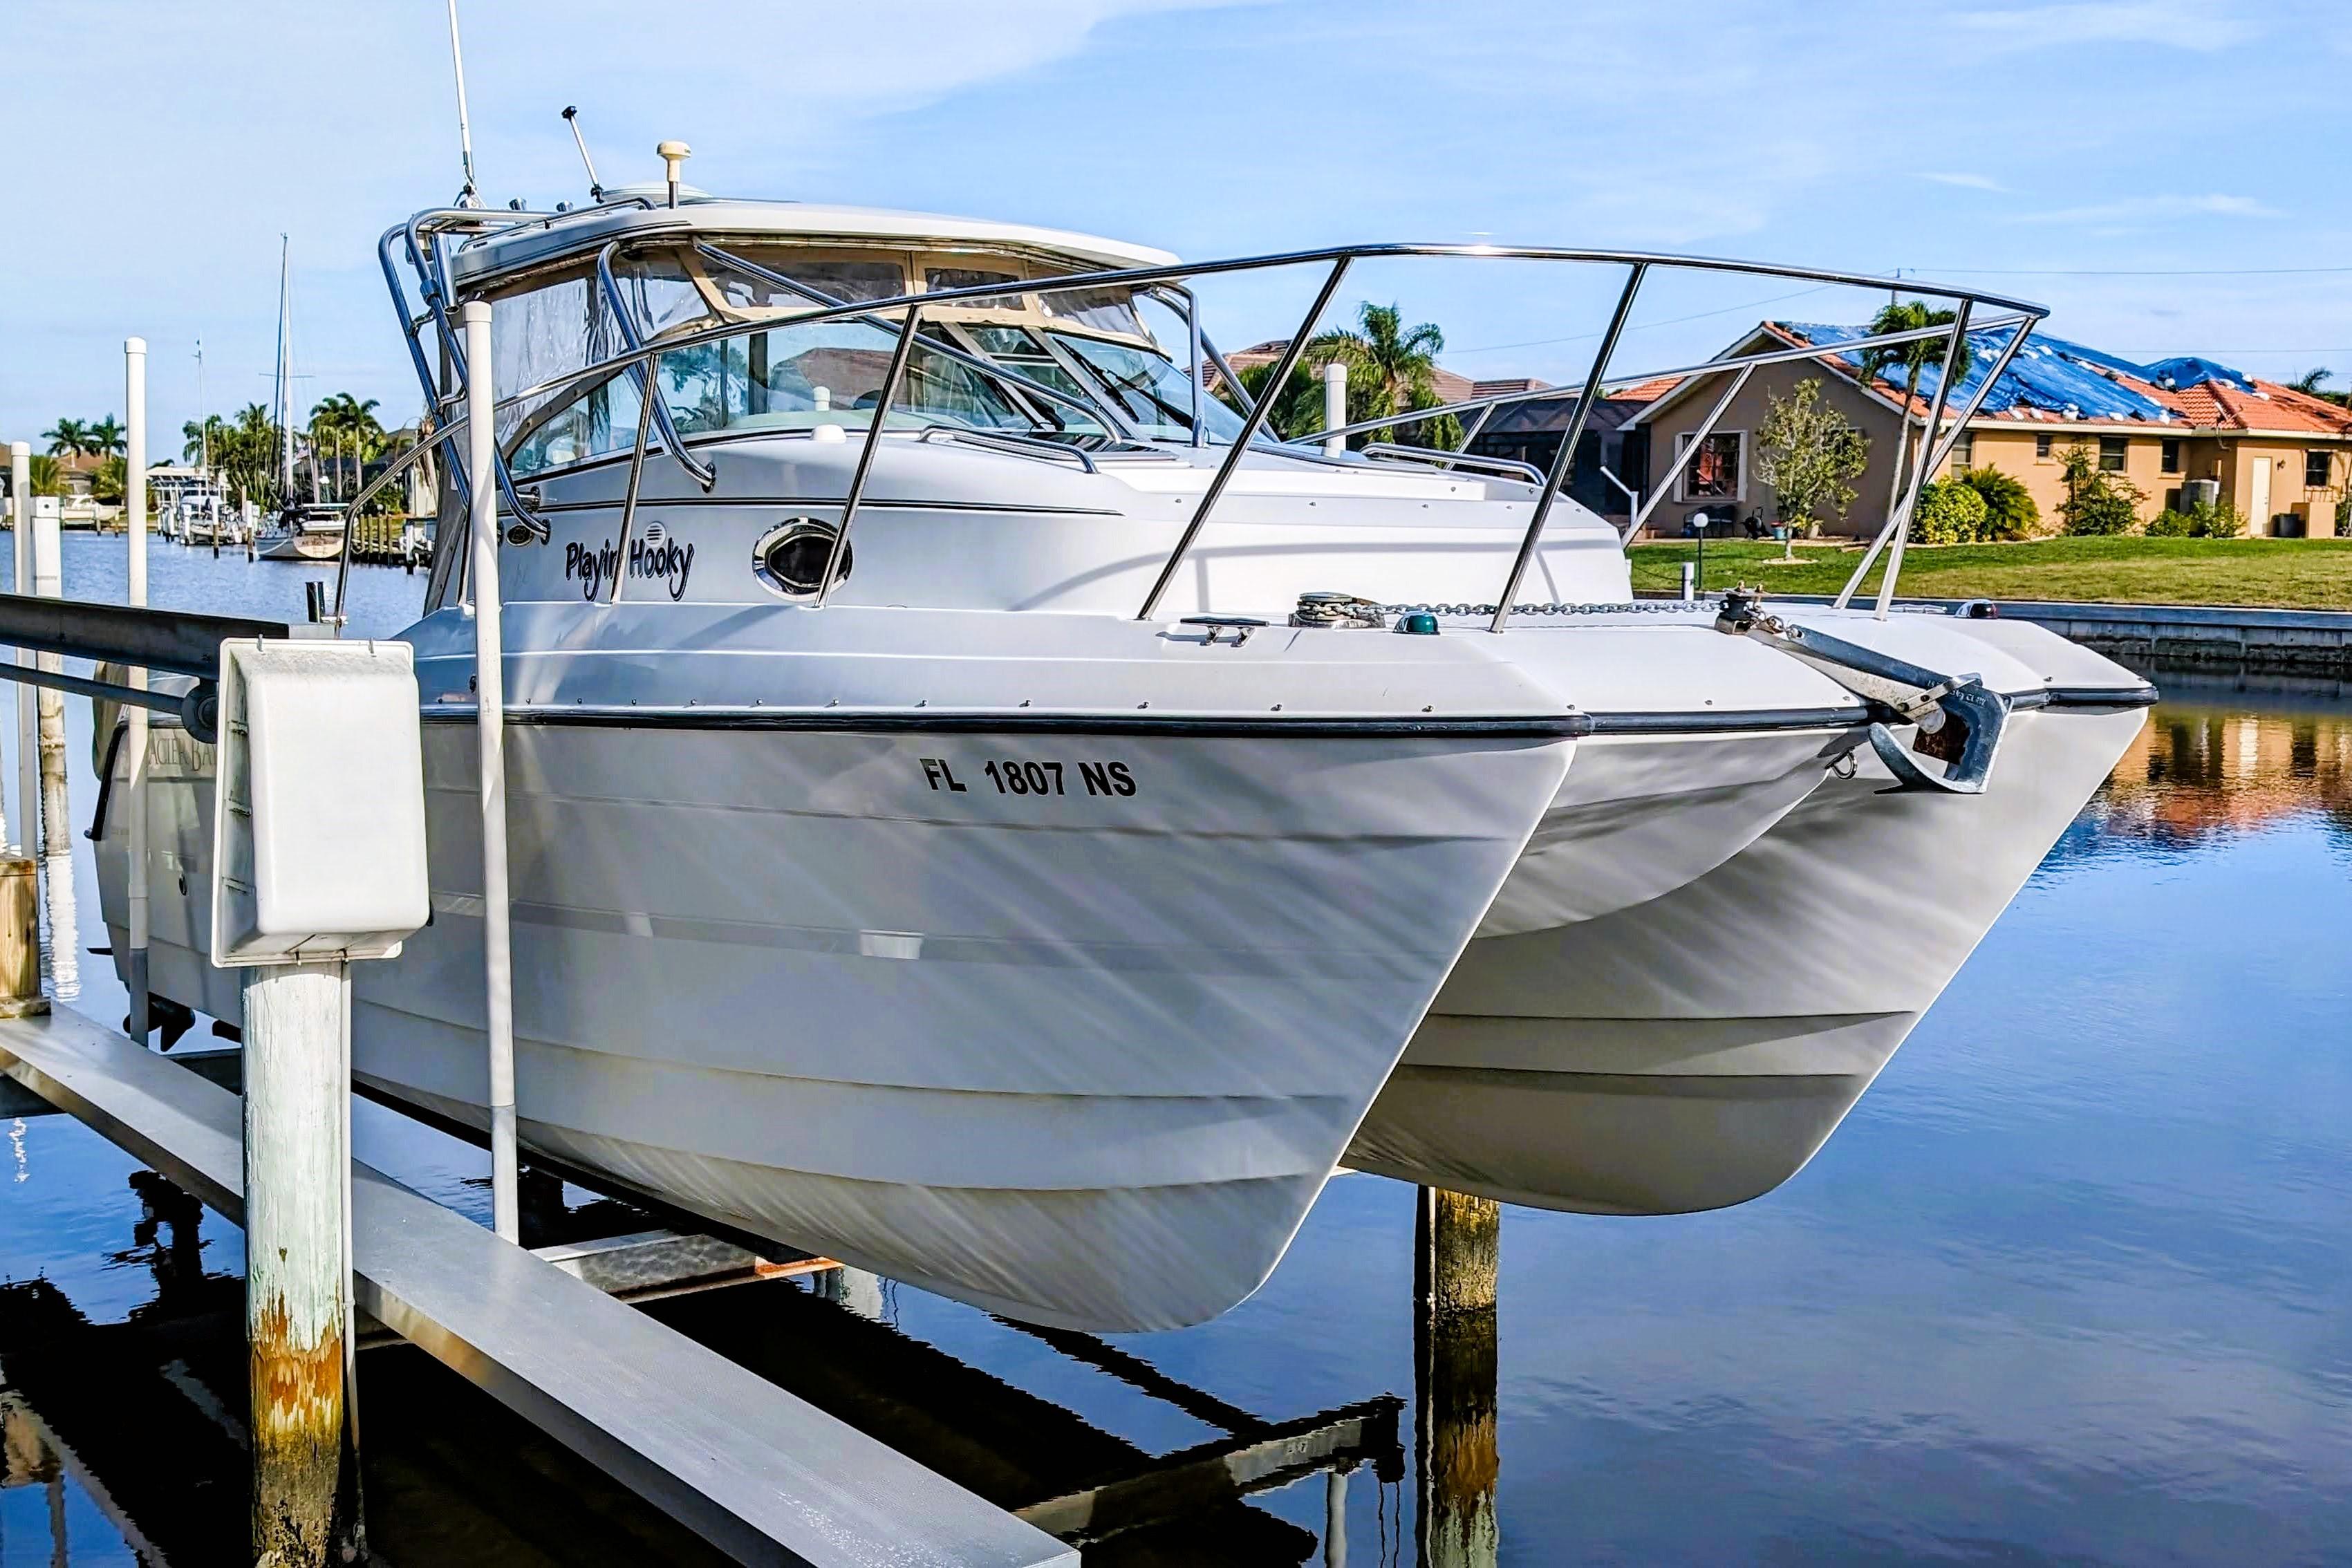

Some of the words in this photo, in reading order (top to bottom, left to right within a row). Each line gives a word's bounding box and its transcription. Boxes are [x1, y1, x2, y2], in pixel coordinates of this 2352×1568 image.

[629, 537, 694, 601] Hooky
[920, 758, 967, 792] FL
[984, 760, 1065, 796] 1807
[1078, 761, 1137, 796] NS
